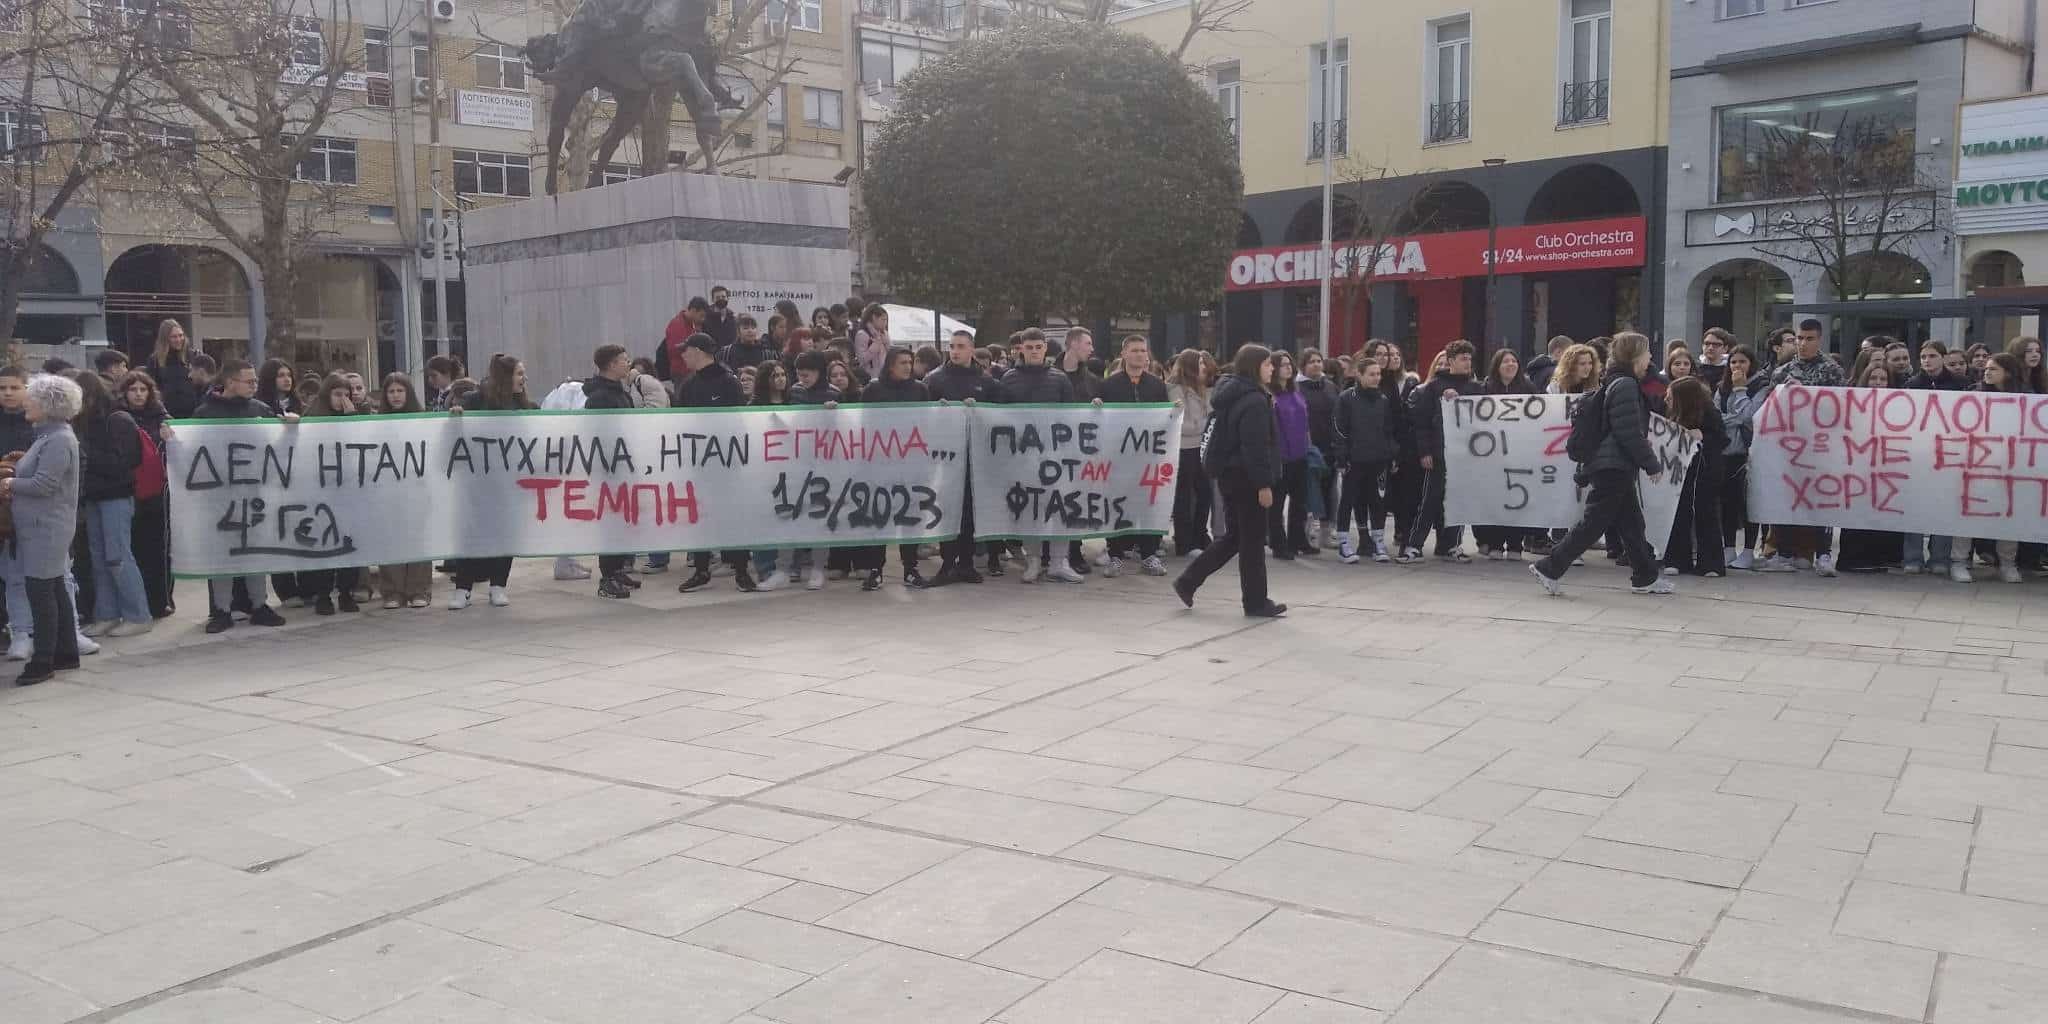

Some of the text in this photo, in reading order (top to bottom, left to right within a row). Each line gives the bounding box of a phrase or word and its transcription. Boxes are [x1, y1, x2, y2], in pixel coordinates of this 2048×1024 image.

[1961, 136, 2048, 156] ΥΠΟΔΗΜ
[1525, 247, 1634, 262] www.shop-orchestra.com
[1535, 230, 1634, 249] Club Orchestra
[1230, 241, 1426, 286] ORCHESTRA
[1453, 395, 1546, 428] ΠΟΣΟ
[990, 423, 1167, 456] ΠΑΡΕ ΜΕ
[1468, 429, 1509, 457] ΟΙ
[1843, 435, 1912, 468] ΜΕ
[185, 443, 294, 490] ΔΕΝ
[318, 440, 427, 488] ΗΤΑΝ
[660, 432, 750, 471] ΗΤΑΝ
[763, 425, 957, 462] ΕΓΚΛΗΜΑ...
[1039, 458, 1113, 486] ΟΤΑΝ
[516, 478, 699, 526] ΤΕΜΠΗ
[771, 471, 943, 531] 1/3/2023
[1005, 481, 1133, 529] ΦΤΑΣΕΙΣ
[1783, 471, 1910, 514] ΧΩΡΙΣ
